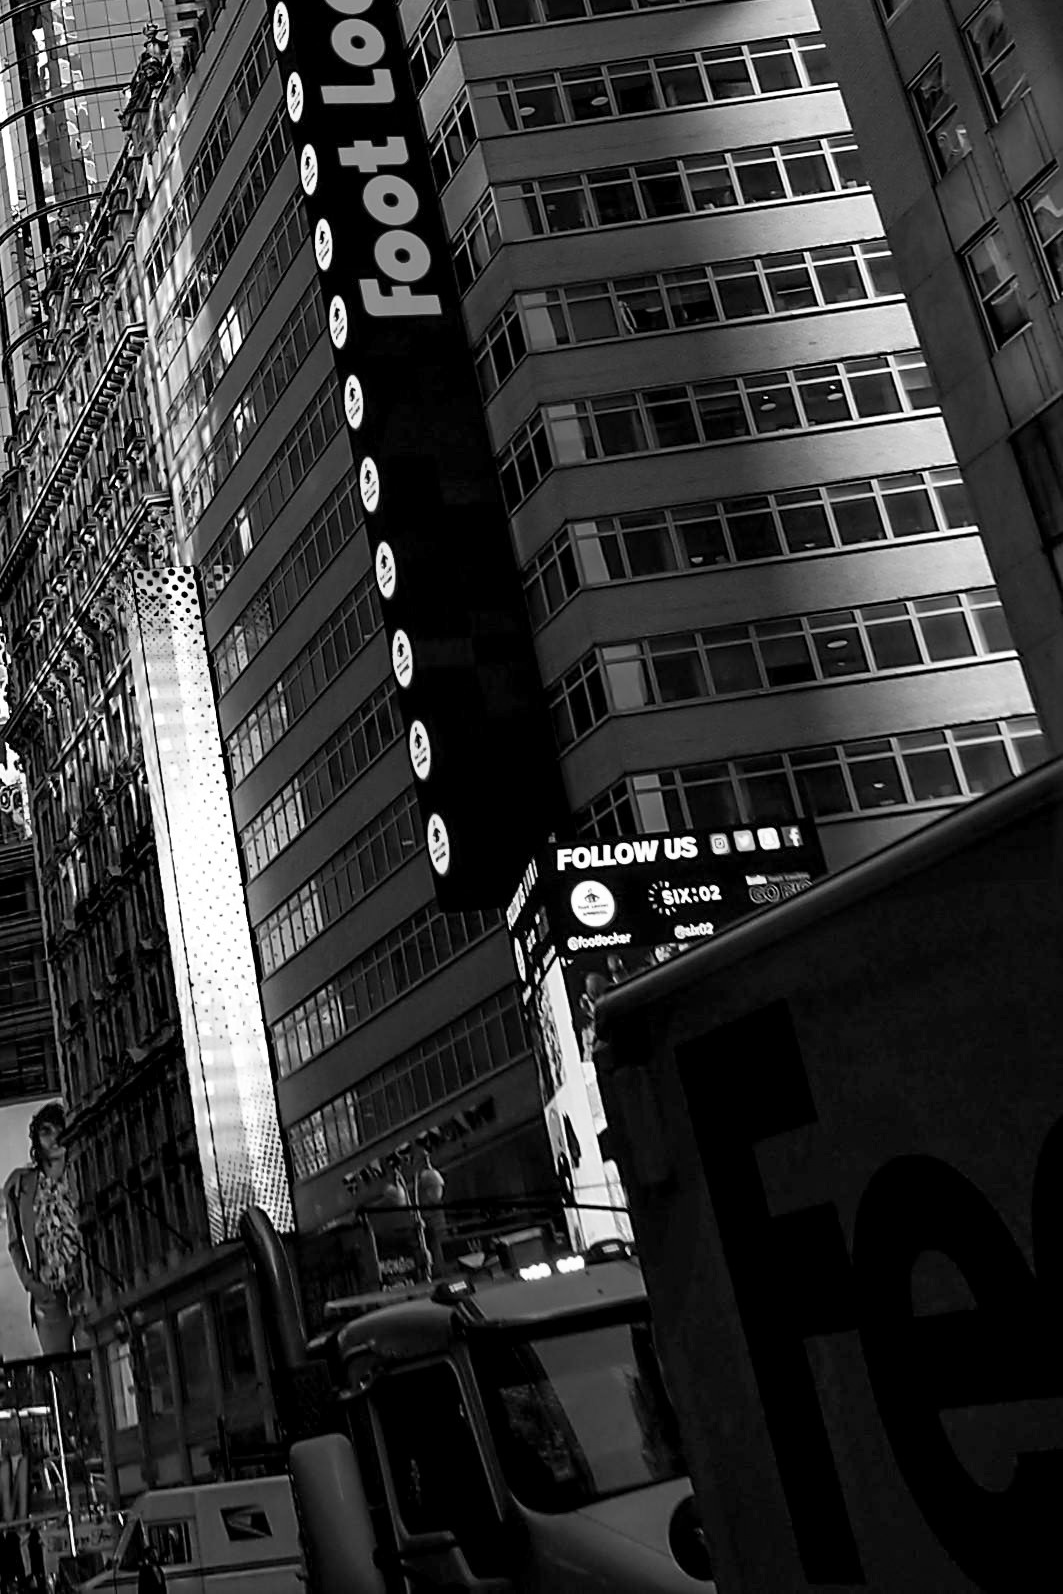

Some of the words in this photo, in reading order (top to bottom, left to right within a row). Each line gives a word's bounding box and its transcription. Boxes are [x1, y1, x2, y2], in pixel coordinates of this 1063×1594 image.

[338, 135, 443, 317] Foot
[556, 839, 659, 871] FOLLOW
[663, 836, 698, 860] US
[661, 884, 722, 906] SIX:02
[567, 932, 632, 951] @footlocker
[676, 998, 1063, 1594] Fe
